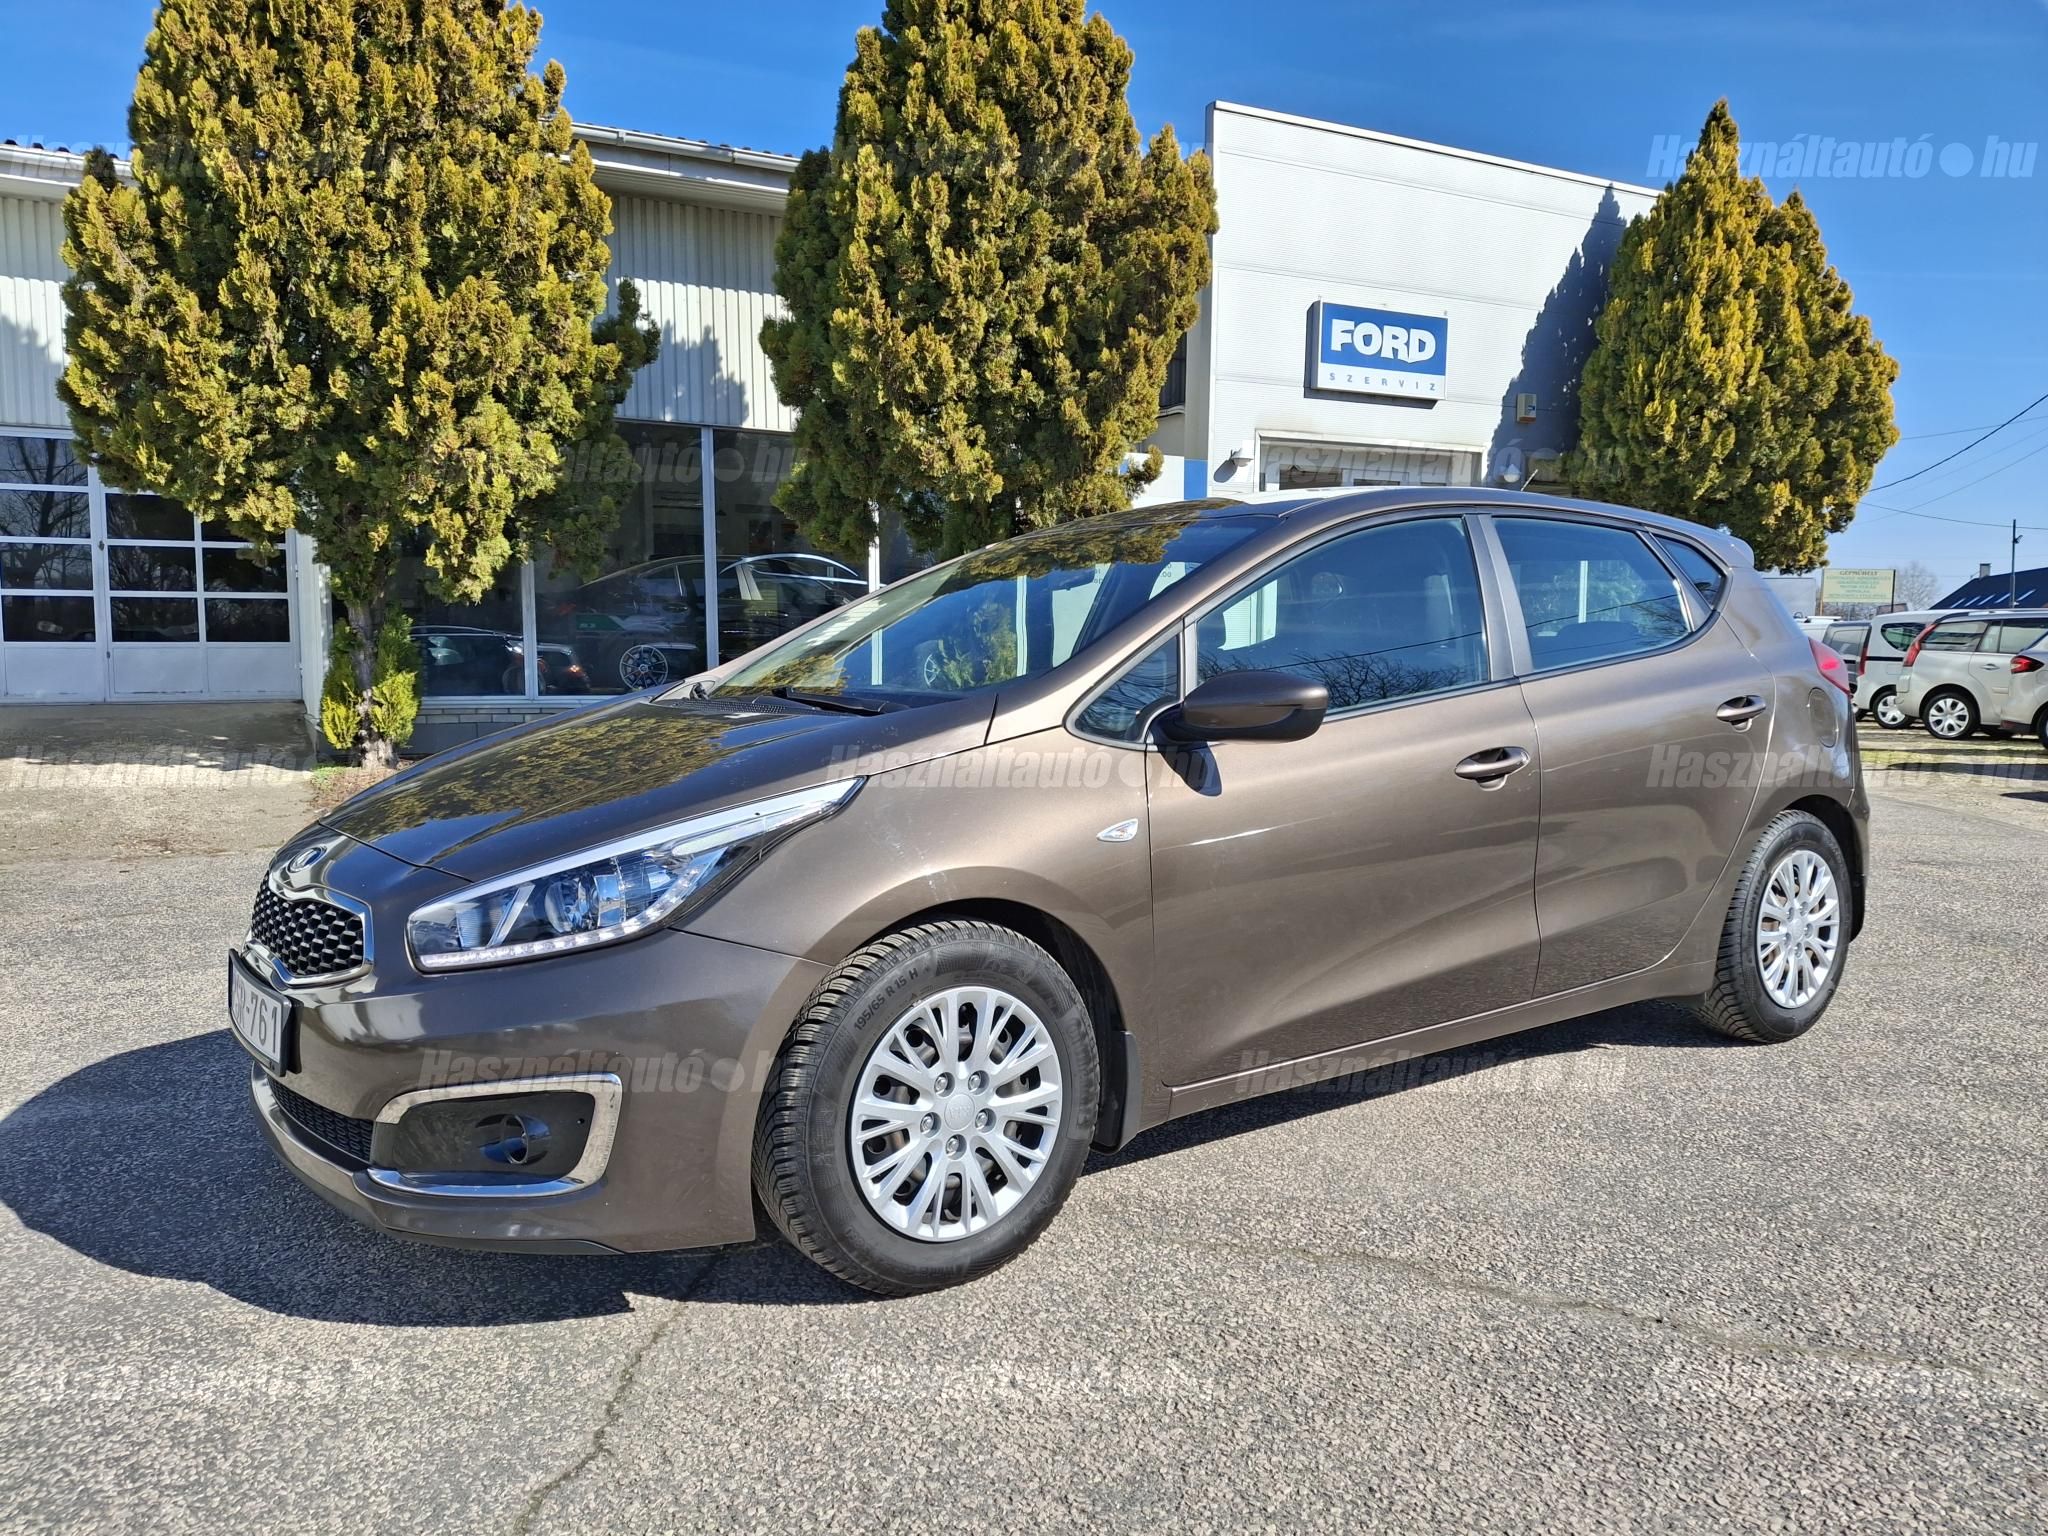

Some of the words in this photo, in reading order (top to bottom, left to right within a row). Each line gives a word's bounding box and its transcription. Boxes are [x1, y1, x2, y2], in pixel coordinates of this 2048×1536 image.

[1331, 319, 1436, 364] FORD
[1330, 373, 1436, 391] SZERVIZ
[854, 994, 886, 1031] 195/65
[885, 986, 895, 998] R
[894, 976, 907, 989] 15
[908, 968, 919, 980] H
